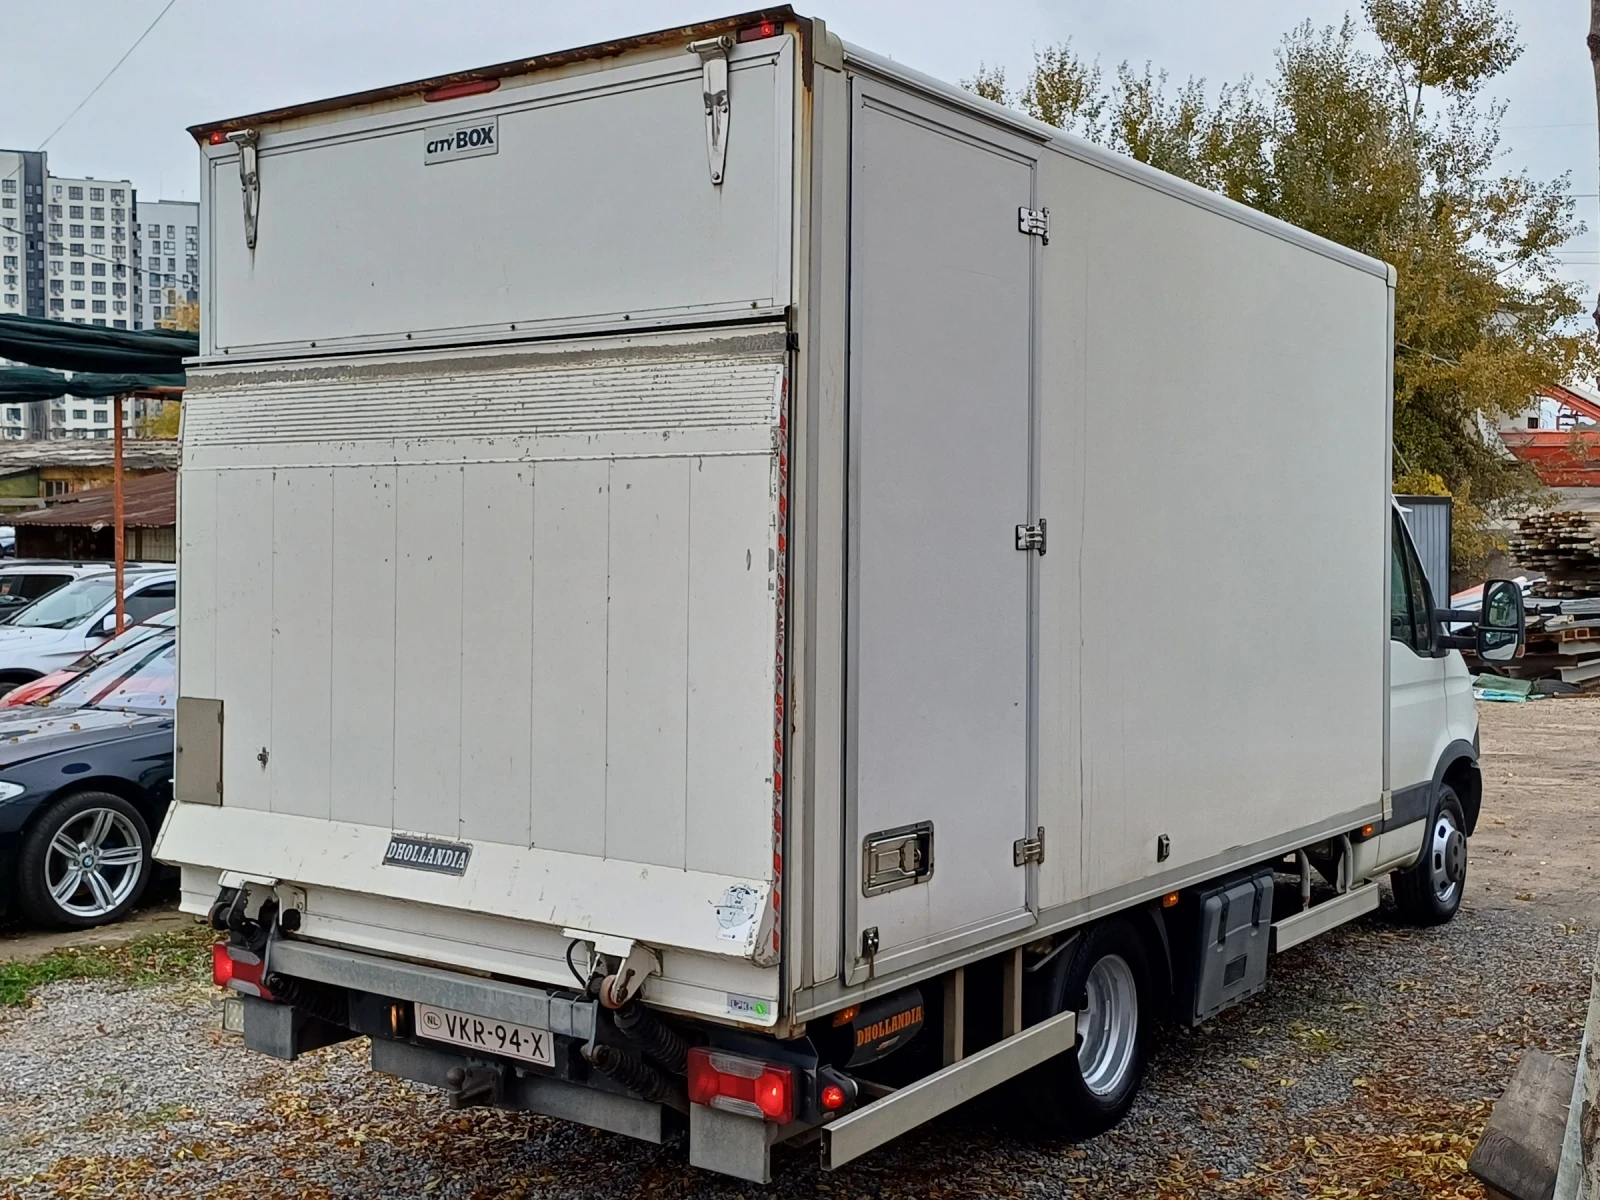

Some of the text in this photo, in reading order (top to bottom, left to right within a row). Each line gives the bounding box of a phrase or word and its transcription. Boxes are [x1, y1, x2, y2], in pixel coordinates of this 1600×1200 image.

[427, 126, 494, 154] CITY BOX
[387, 842, 467, 869] DHOLLANDIA
[427, 1013, 544, 1058] NL VKR-94-X
[857, 1006, 922, 1047] DHOLLANDIA
